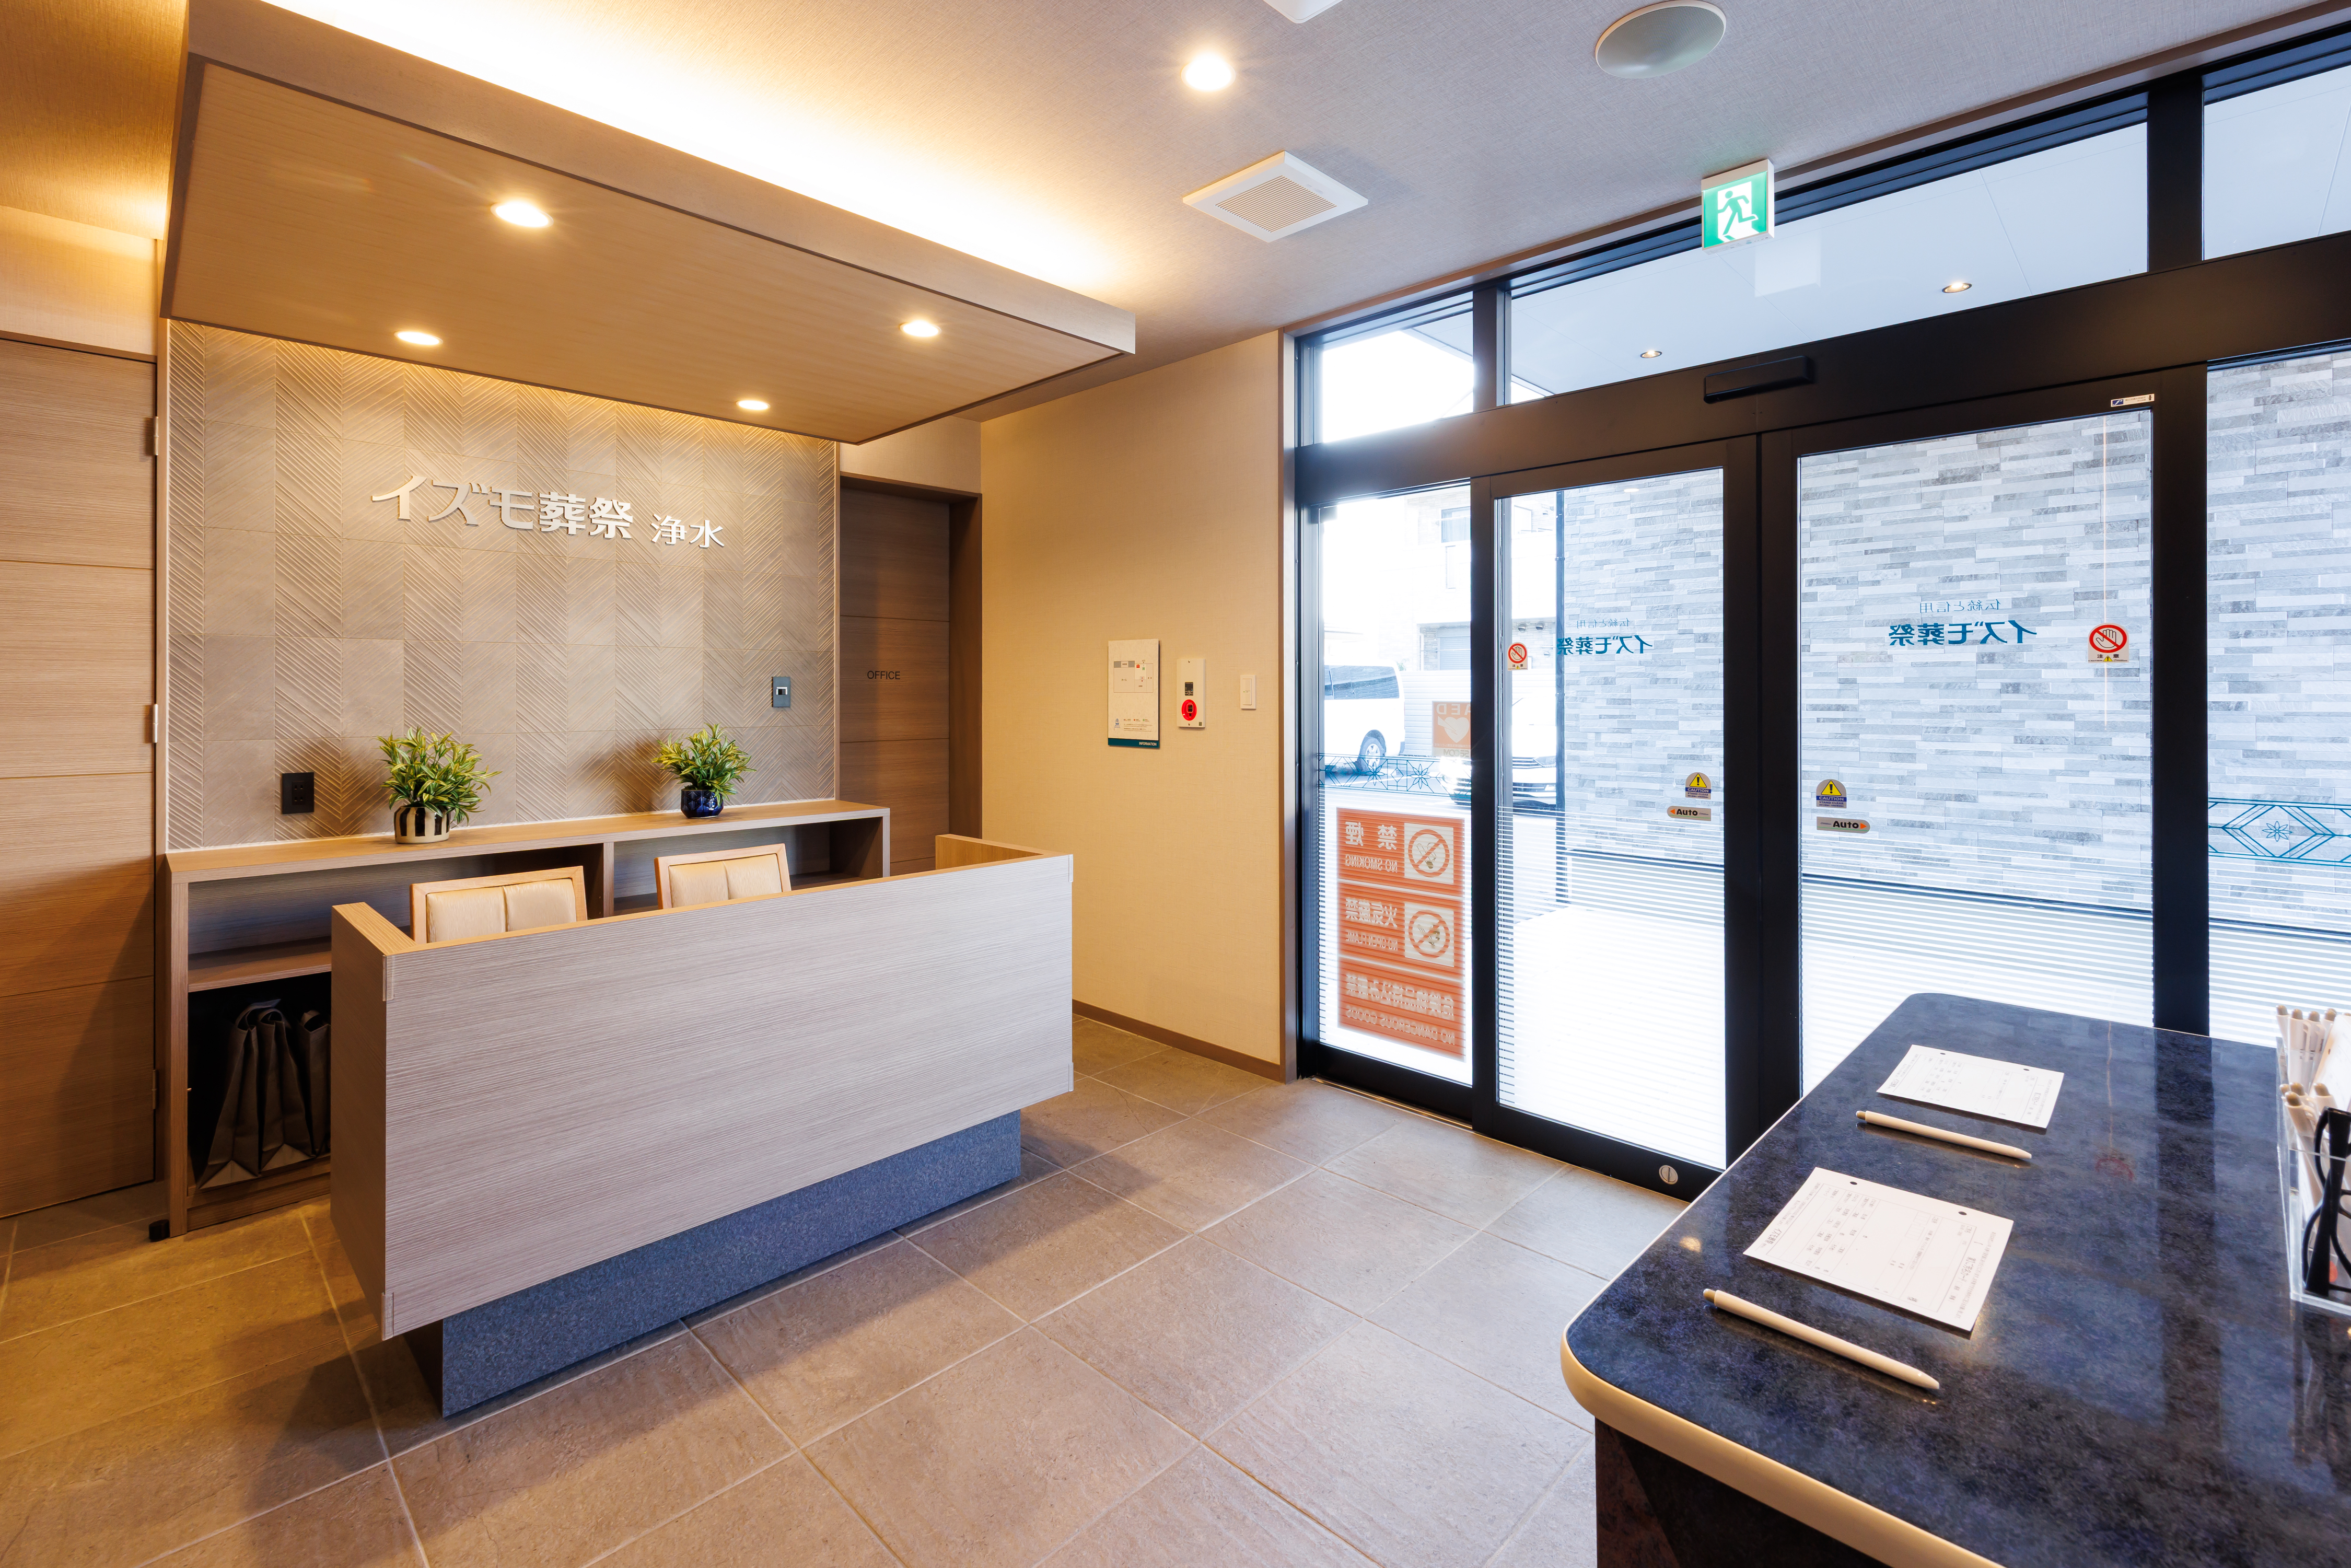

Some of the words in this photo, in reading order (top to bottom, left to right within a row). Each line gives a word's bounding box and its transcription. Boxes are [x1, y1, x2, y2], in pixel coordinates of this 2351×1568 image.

[371, 475, 633, 539] イズモ葬祭
[650, 513, 725, 548] 浄水
[867, 670, 900, 679] OFFICE
[1833, 820, 1859, 829] Auto
[1763, 1227, 1783, 1244] イズモ葬祭
